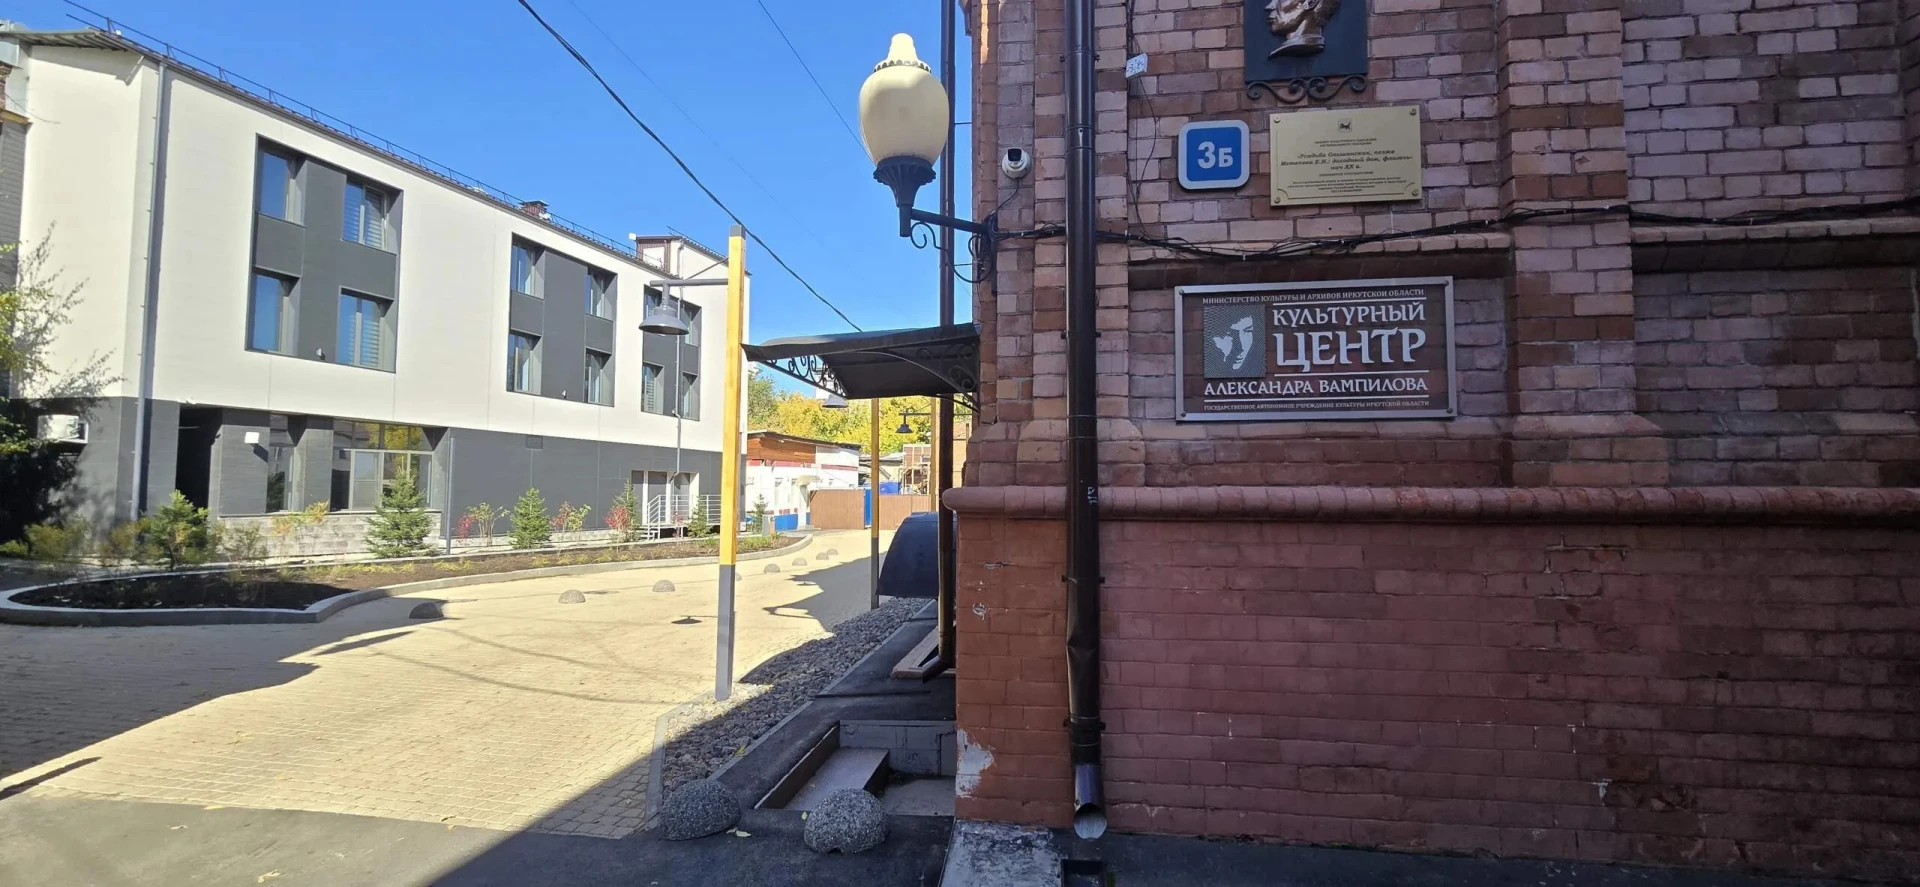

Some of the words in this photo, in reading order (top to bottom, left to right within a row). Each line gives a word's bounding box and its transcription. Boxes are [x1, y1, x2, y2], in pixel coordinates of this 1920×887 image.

[1197, 141, 1234, 169] 3Б
[1202, 295, 1260, 304] МИНИСТЕРСТВО
[1261, 294, 1299, 302] КУЛЬТУРЫ
[1307, 292, 1341, 300] АРХИВОВ
[1388, 288, 1424, 297] ОБЛАСТИ
[1272, 301, 1426, 328] КУЛЬТУРНЫЙ
[1272, 327, 1426, 372] ЦЕНТР
[1204, 380, 1314, 395] АЛЕКСАНДРА
[1319, 377, 1428, 393] ВАМПИЛОВА
[1366, 400, 1401, 408] ИРКУТСКОЙ
